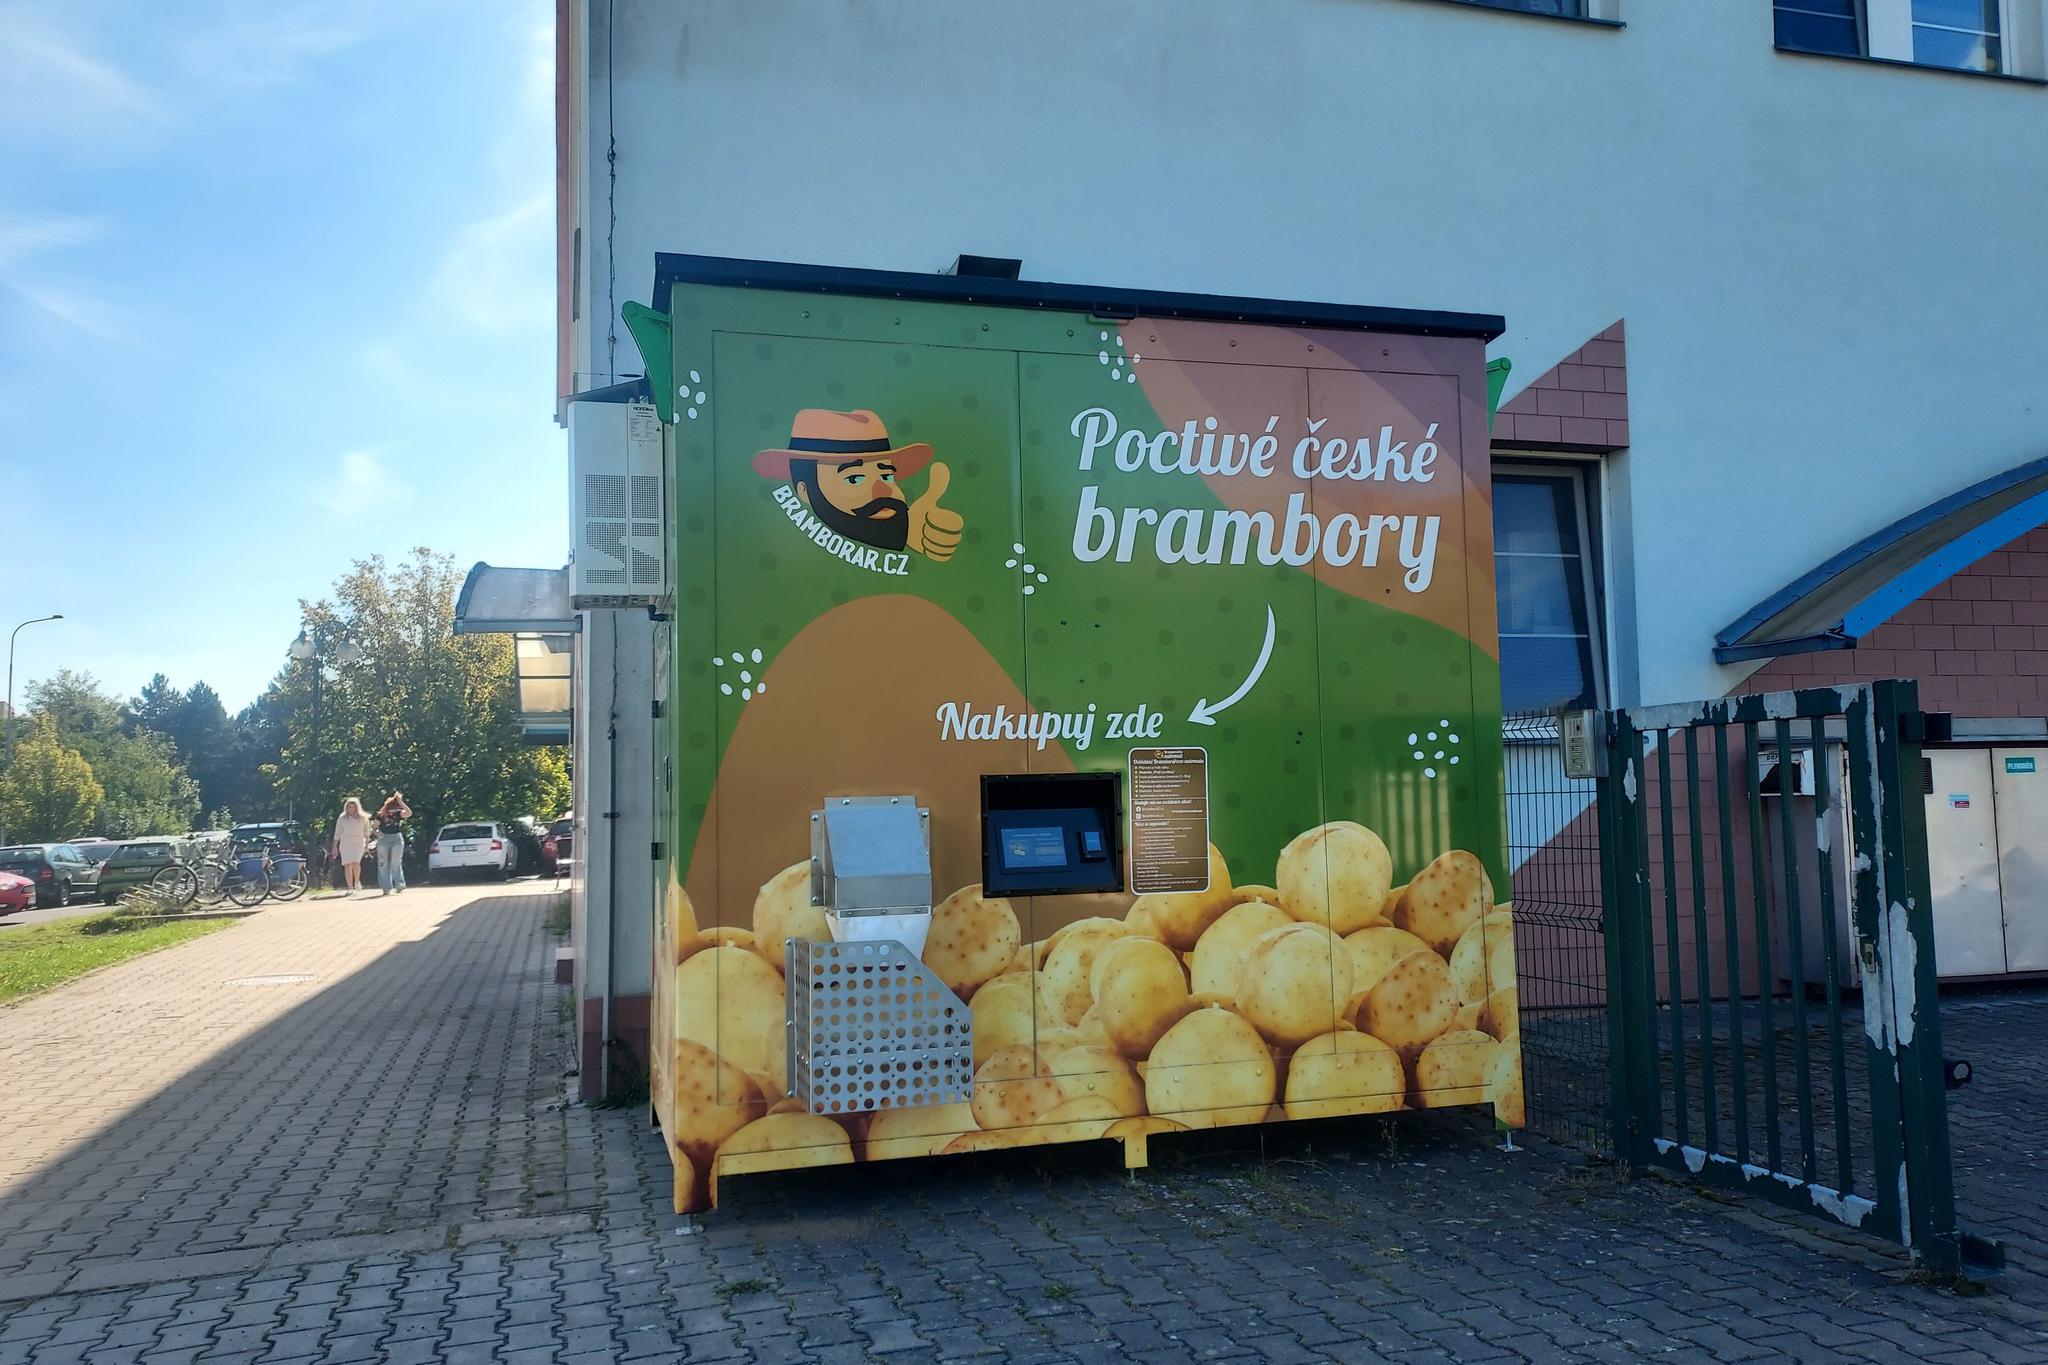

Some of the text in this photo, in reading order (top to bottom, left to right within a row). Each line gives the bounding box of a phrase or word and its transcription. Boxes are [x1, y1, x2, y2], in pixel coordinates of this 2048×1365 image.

[1070, 407, 1440, 483] Poctivé české
[772, 485, 909, 576] BRAMBORAR.CZ
[1072, 485, 1441, 593] brambory
[936, 702, 1164, 751] Nakupuj zde
